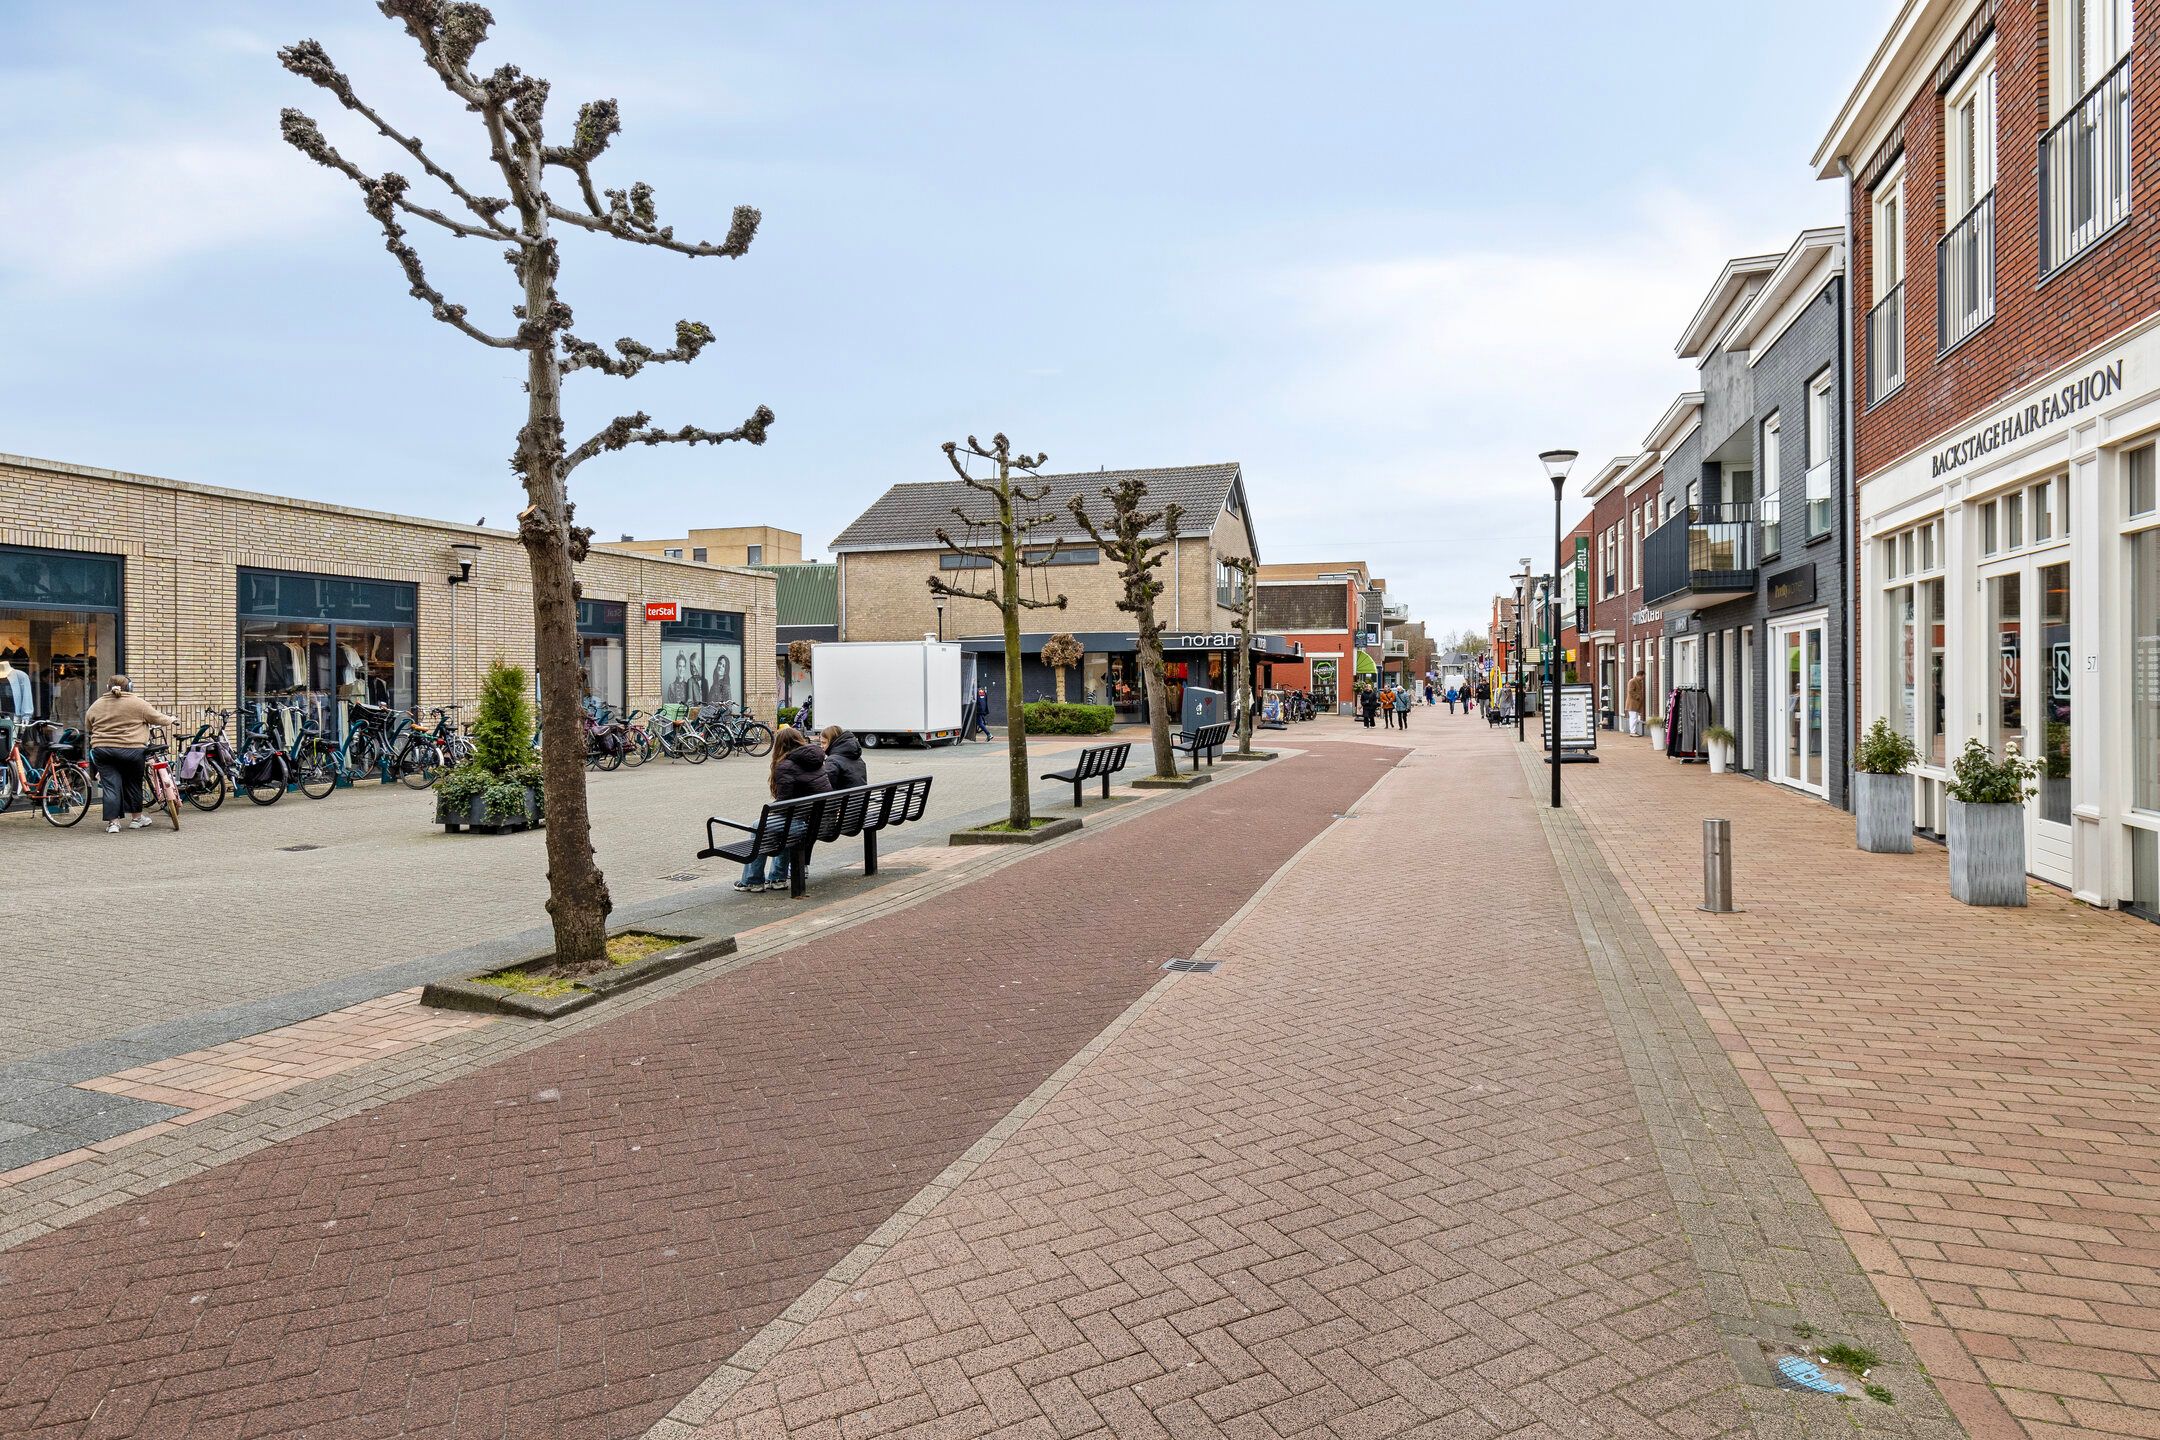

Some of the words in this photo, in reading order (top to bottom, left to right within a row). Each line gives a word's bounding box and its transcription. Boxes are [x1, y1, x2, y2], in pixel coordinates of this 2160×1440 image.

[1577, 548, 1588, 572] TURF
[648, 607, 675, 616] terStal
[1181, 632, 1236, 647] norah
[2087, 656, 2096, 670] 57
